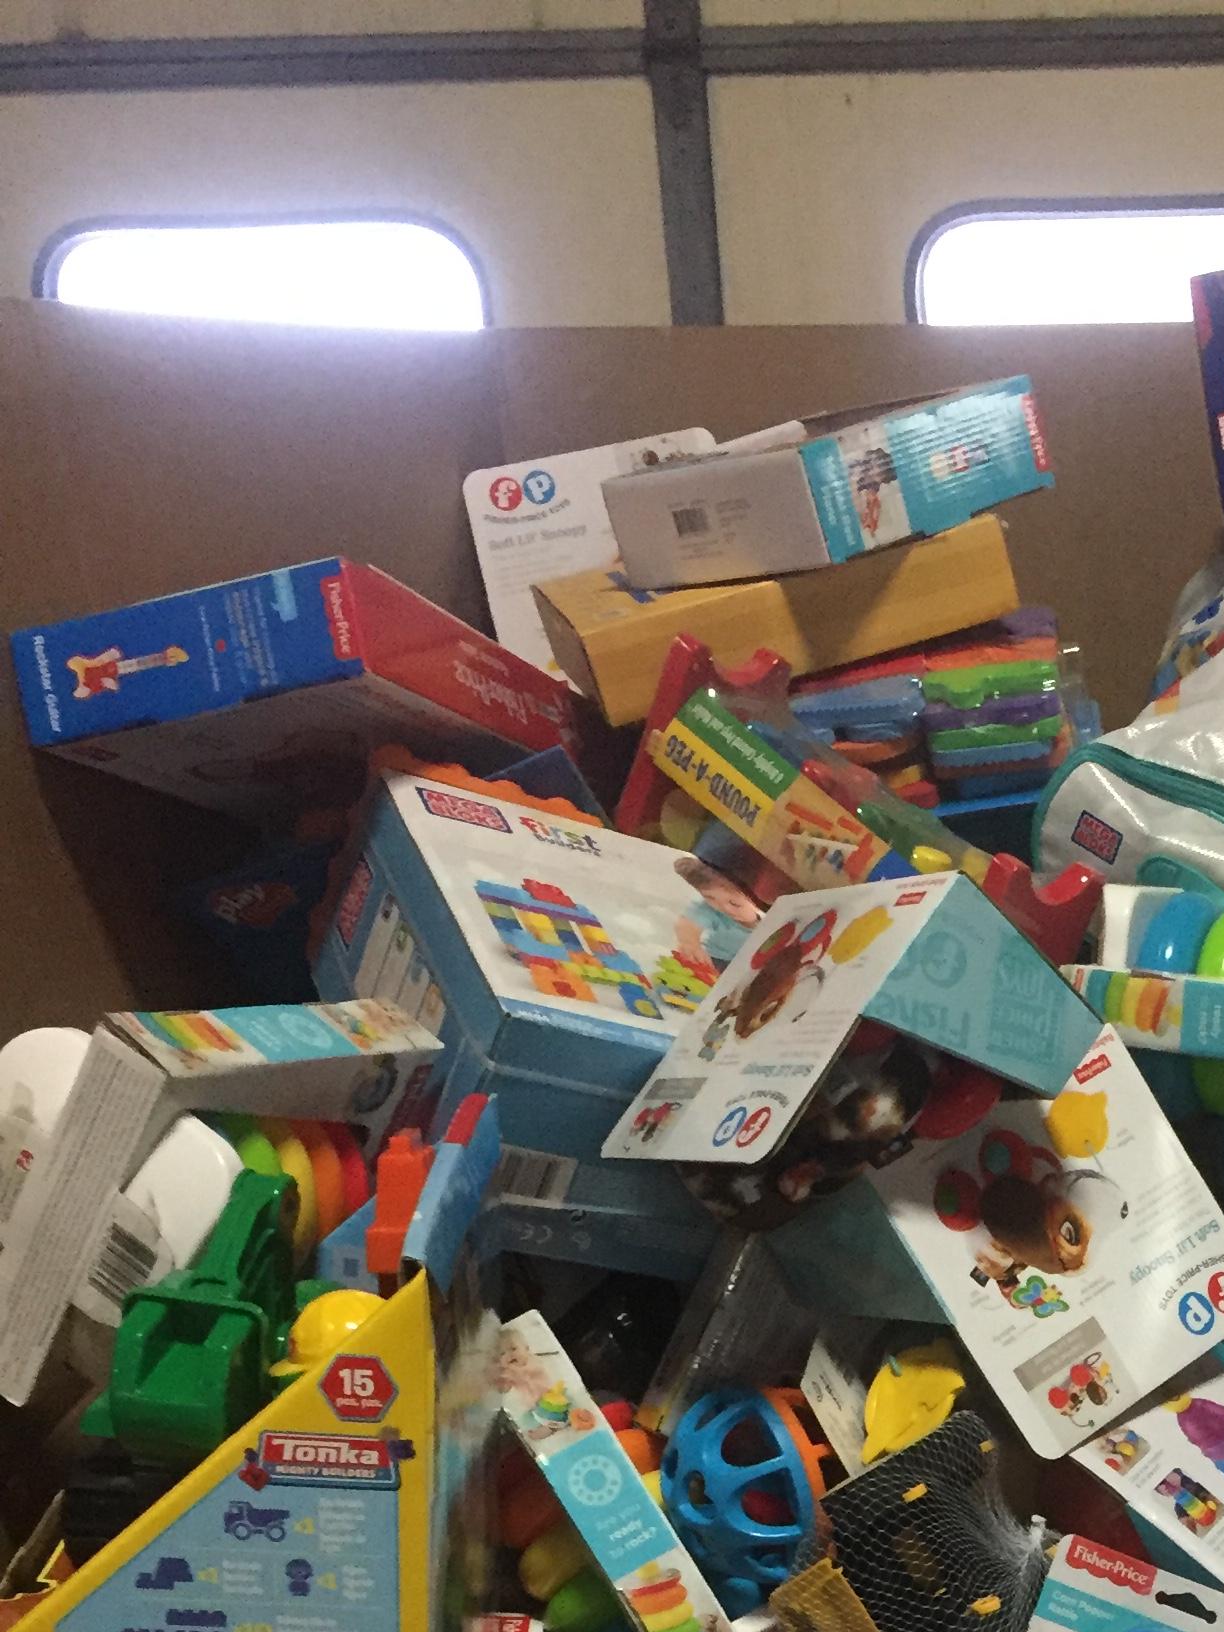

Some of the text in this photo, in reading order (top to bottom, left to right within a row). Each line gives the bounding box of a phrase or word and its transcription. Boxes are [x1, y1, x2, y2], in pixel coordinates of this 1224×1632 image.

[339, 1368, 375, 1397] 15
[272, 1438, 380, 1465] Tonka
[1073, 1544, 1150, 1586] Fisher-Price
